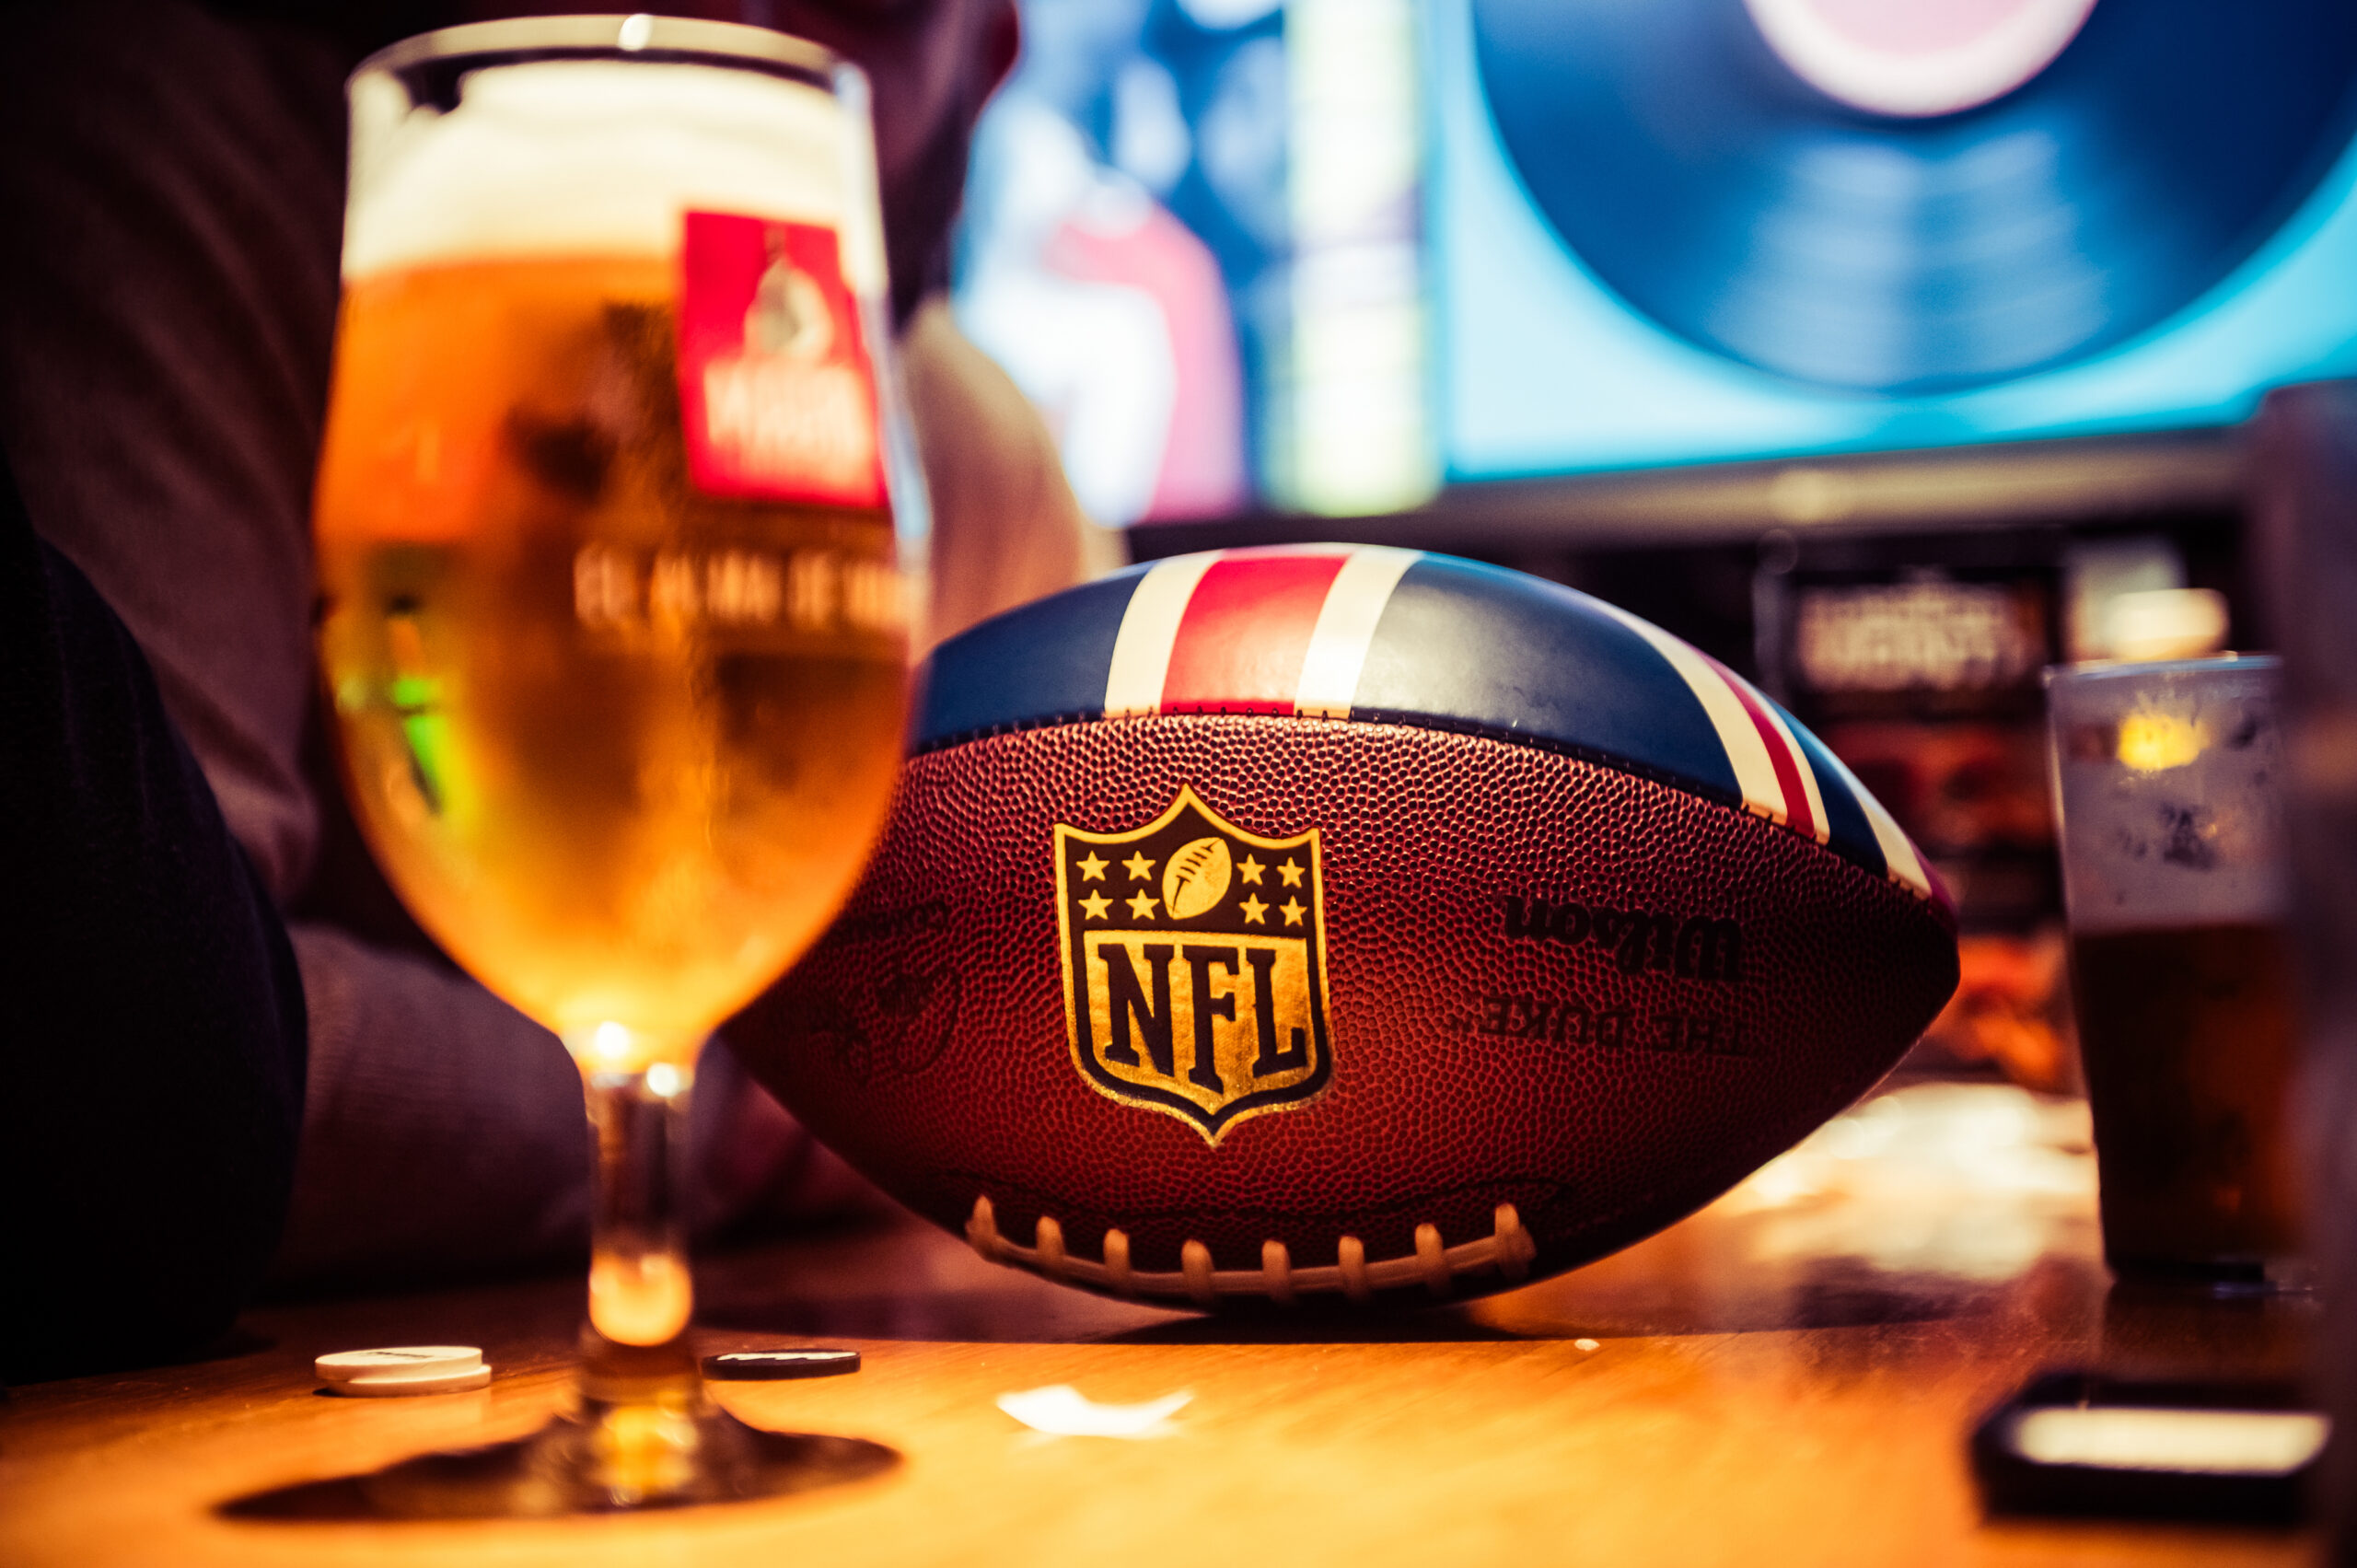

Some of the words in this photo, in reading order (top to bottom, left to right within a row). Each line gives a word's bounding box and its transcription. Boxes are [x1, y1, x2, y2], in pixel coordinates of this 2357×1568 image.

[1504, 894, 1746, 982] Wilson
[1097, 943, 1308, 1096] NFL
[1652, 1014, 1753, 1058] THE
